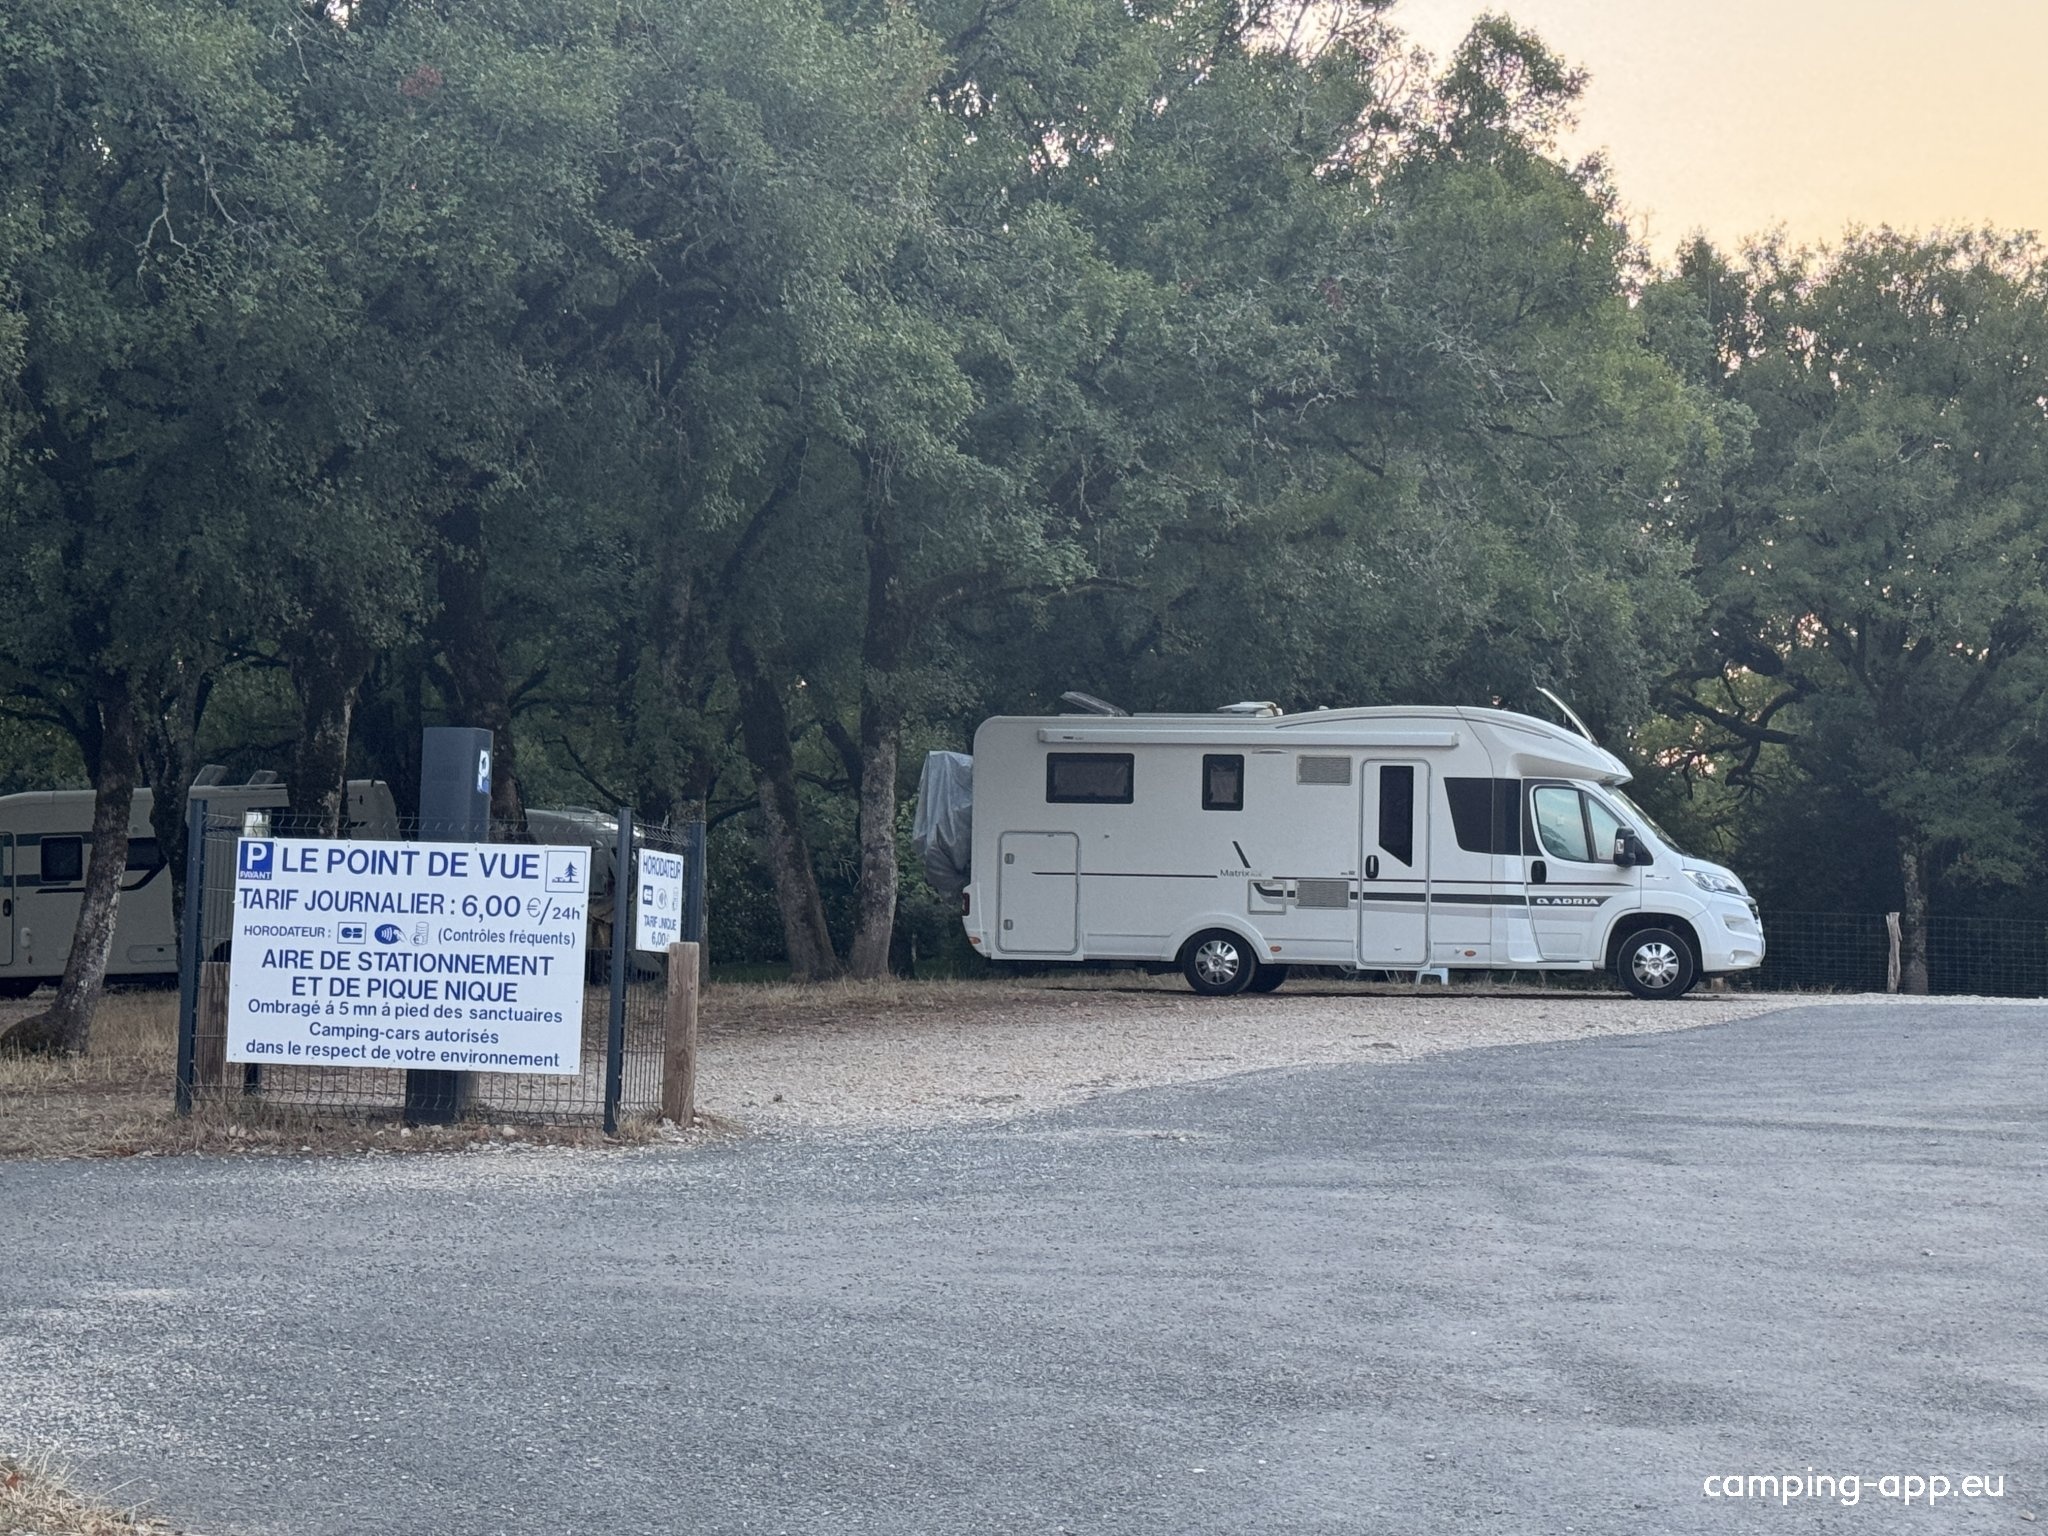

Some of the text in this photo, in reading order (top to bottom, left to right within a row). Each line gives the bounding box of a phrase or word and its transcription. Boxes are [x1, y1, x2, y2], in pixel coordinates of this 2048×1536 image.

[247, 843, 267, 870] P
[282, 847, 540, 880] LE POINT DE VUE
[643, 855, 682, 880] HORODATEUR
[1220, 869, 1250, 877] Matrix
[239, 888, 299, 911] TARIF
[438, 928, 505, 945] (Contrôles
[509, 929, 576, 948] fréquents)
[261, 949, 554, 976] AIRE DE STATIONNEMENT
[292, 976, 518, 1003] ET DE PIQUE NIQUE
[248, 998, 320, 1017] Ombragé
[339, 1002, 349, 1015] 5
[353, 1005, 377, 1016] mn
[395, 1003, 429, 1020] pied
[433, 1004, 463, 1019] des
[469, 1007, 563, 1023] sanctuaires
[309, 1022, 499, 1044] Camping-cars autorisés
[246, 1039, 560, 1068] dans le respect de votre environnement
